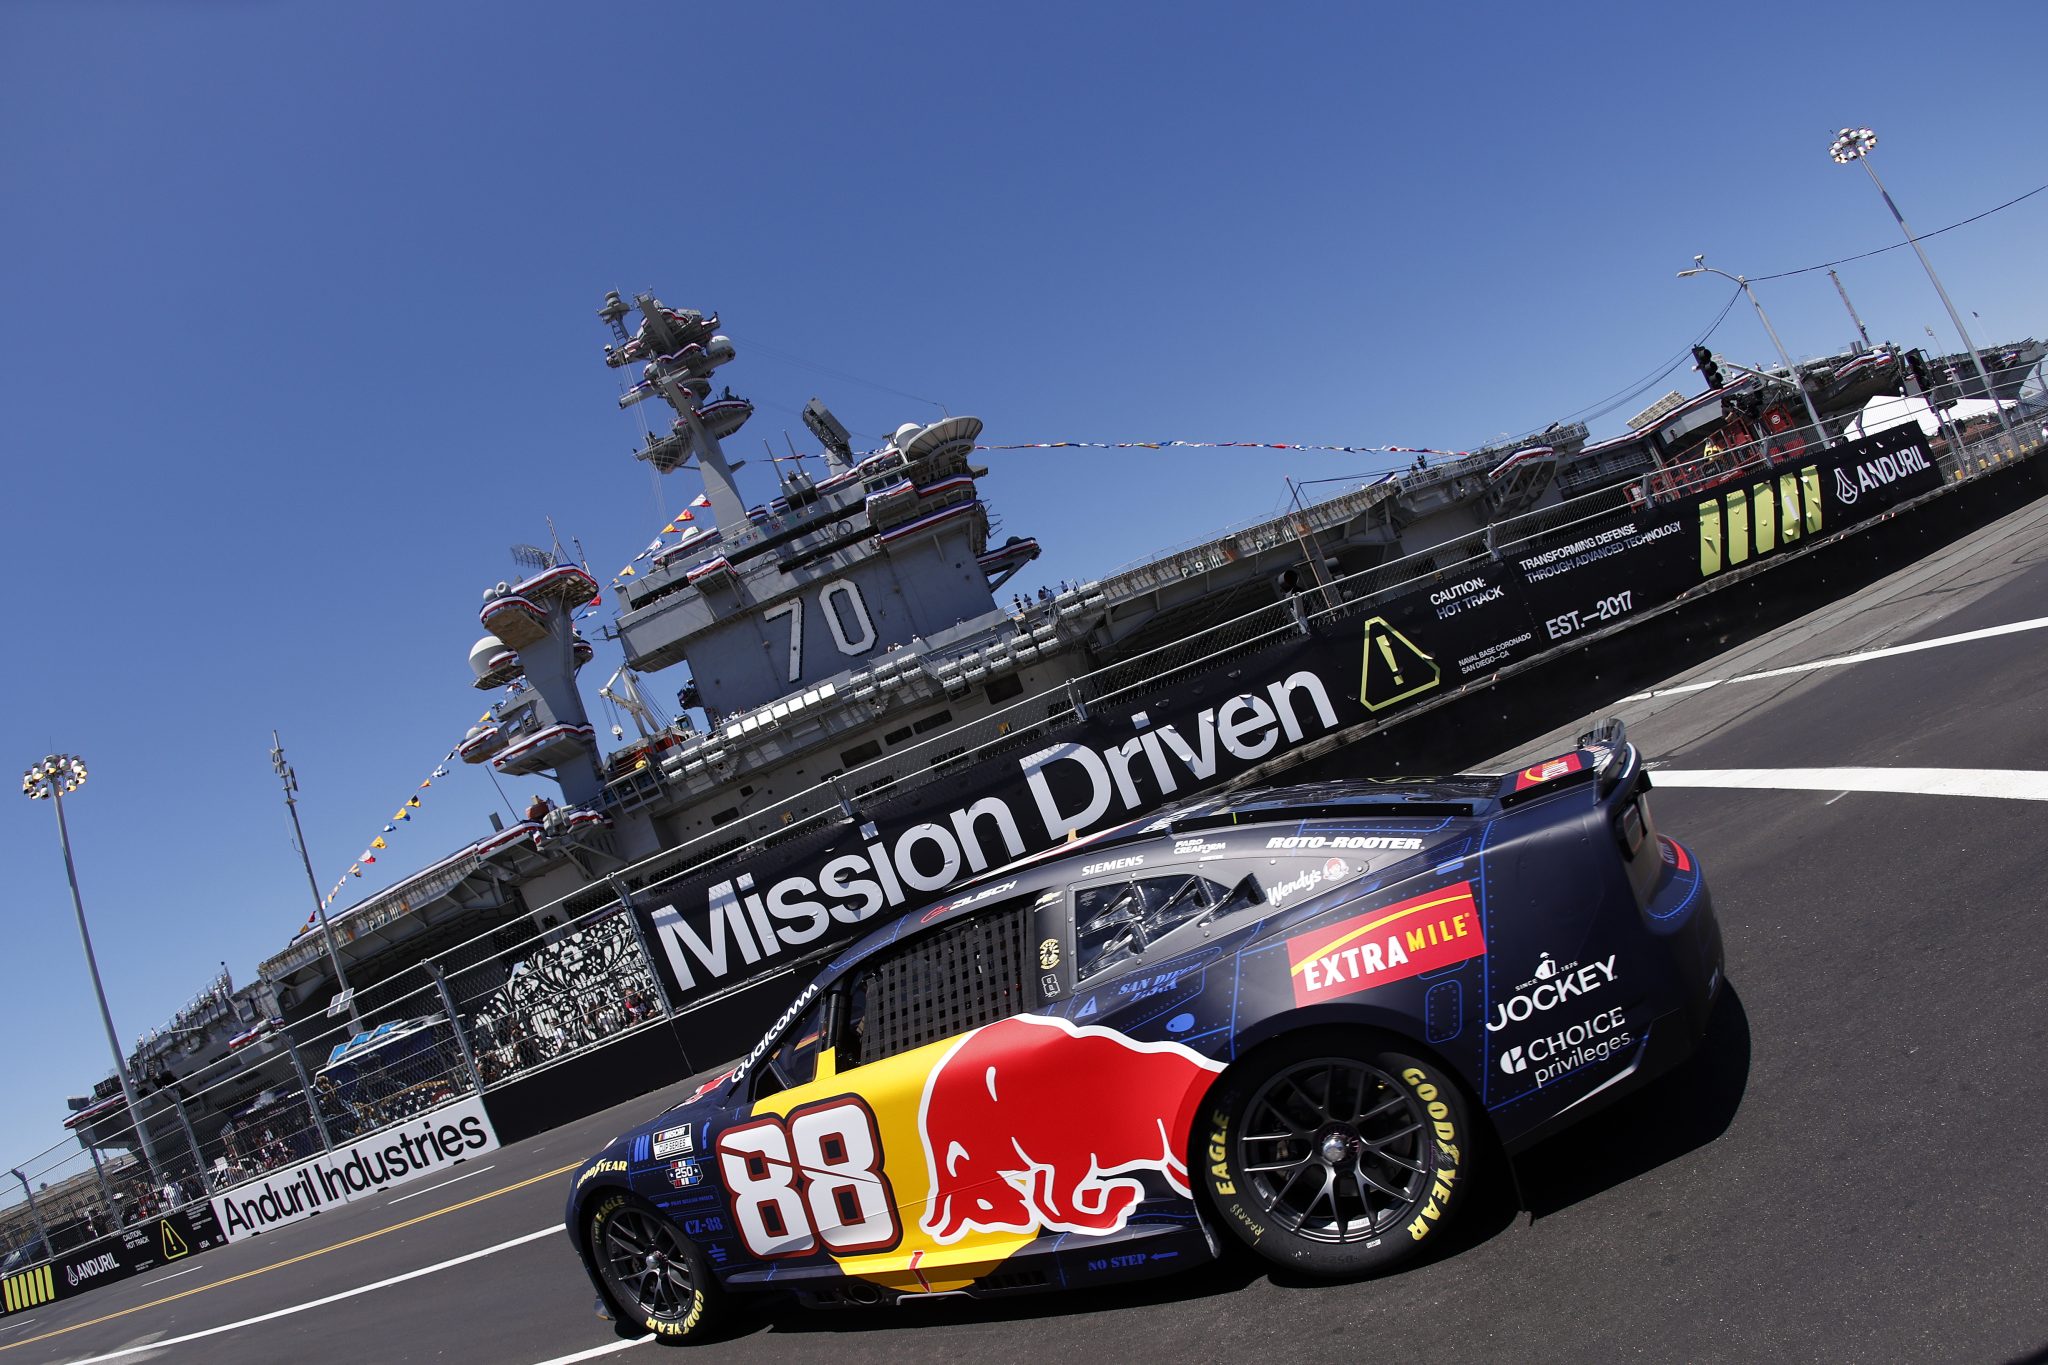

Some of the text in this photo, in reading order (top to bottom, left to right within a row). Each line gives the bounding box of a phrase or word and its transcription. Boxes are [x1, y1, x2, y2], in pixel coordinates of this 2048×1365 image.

[1859, 444, 1931, 493] ANDURIL
[1519, 523, 1637, 571] TRANSFORMING DEFENSE
[1525, 521, 1682, 584] THROUGH ADVANCED TECHNOLOGY
[1430, 577, 1487, 605] CAUTION:
[1436, 586, 1504, 620] HOT TRACK
[764, 578, 879, 684] 70
[1458, 632, 1532, 667] NAVAL BASE CORONADO
[1461, 663, 1476, 674] SAN
[650, 670, 1339, 991] Mission Driven
[1265, 836, 1422, 850] ROTO-ROOTER
[1082, 855, 1144, 876] SIEMENS
[1174, 843, 1226, 854] CREAFORM
[1266, 868, 1322, 906] Wendy's
[1303, 912, 1470, 992] EXTRA MILE
[1486, 954, 1616, 1032] JOCKEY
[1514, 978, 1538, 991] SINCE
[731, 983, 819, 1083] Qualcomm
[1528, 1006, 1626, 1061] CHOICE
[1534, 1032, 1631, 1089] privileges
[659, 1139, 686, 1152] CUP SERIES
[664, 1127, 686, 1140] NASCAR
[1208, 1108, 1237, 1196] EAGLE
[1402, 1067, 1462, 1241] GOODYEAR
[223, 1116, 488, 1236] Anduril Industries
[576, 1158, 628, 1189] GOODYEAR
[675, 1166, 693, 1179] 250
[717, 1097, 900, 1260] 88
[595, 1195, 625, 1223] EAGLE
[684, 1216, 723, 1235] CZ-88
[125, 1235, 150, 1250] HOT TRACK
[199, 1240, 211, 1249] USA
[77, 1252, 120, 1281] ANDURIL
[1088, 1252, 1147, 1273] NO STEP
[646, 1289, 704, 1335] GOODYEAR
